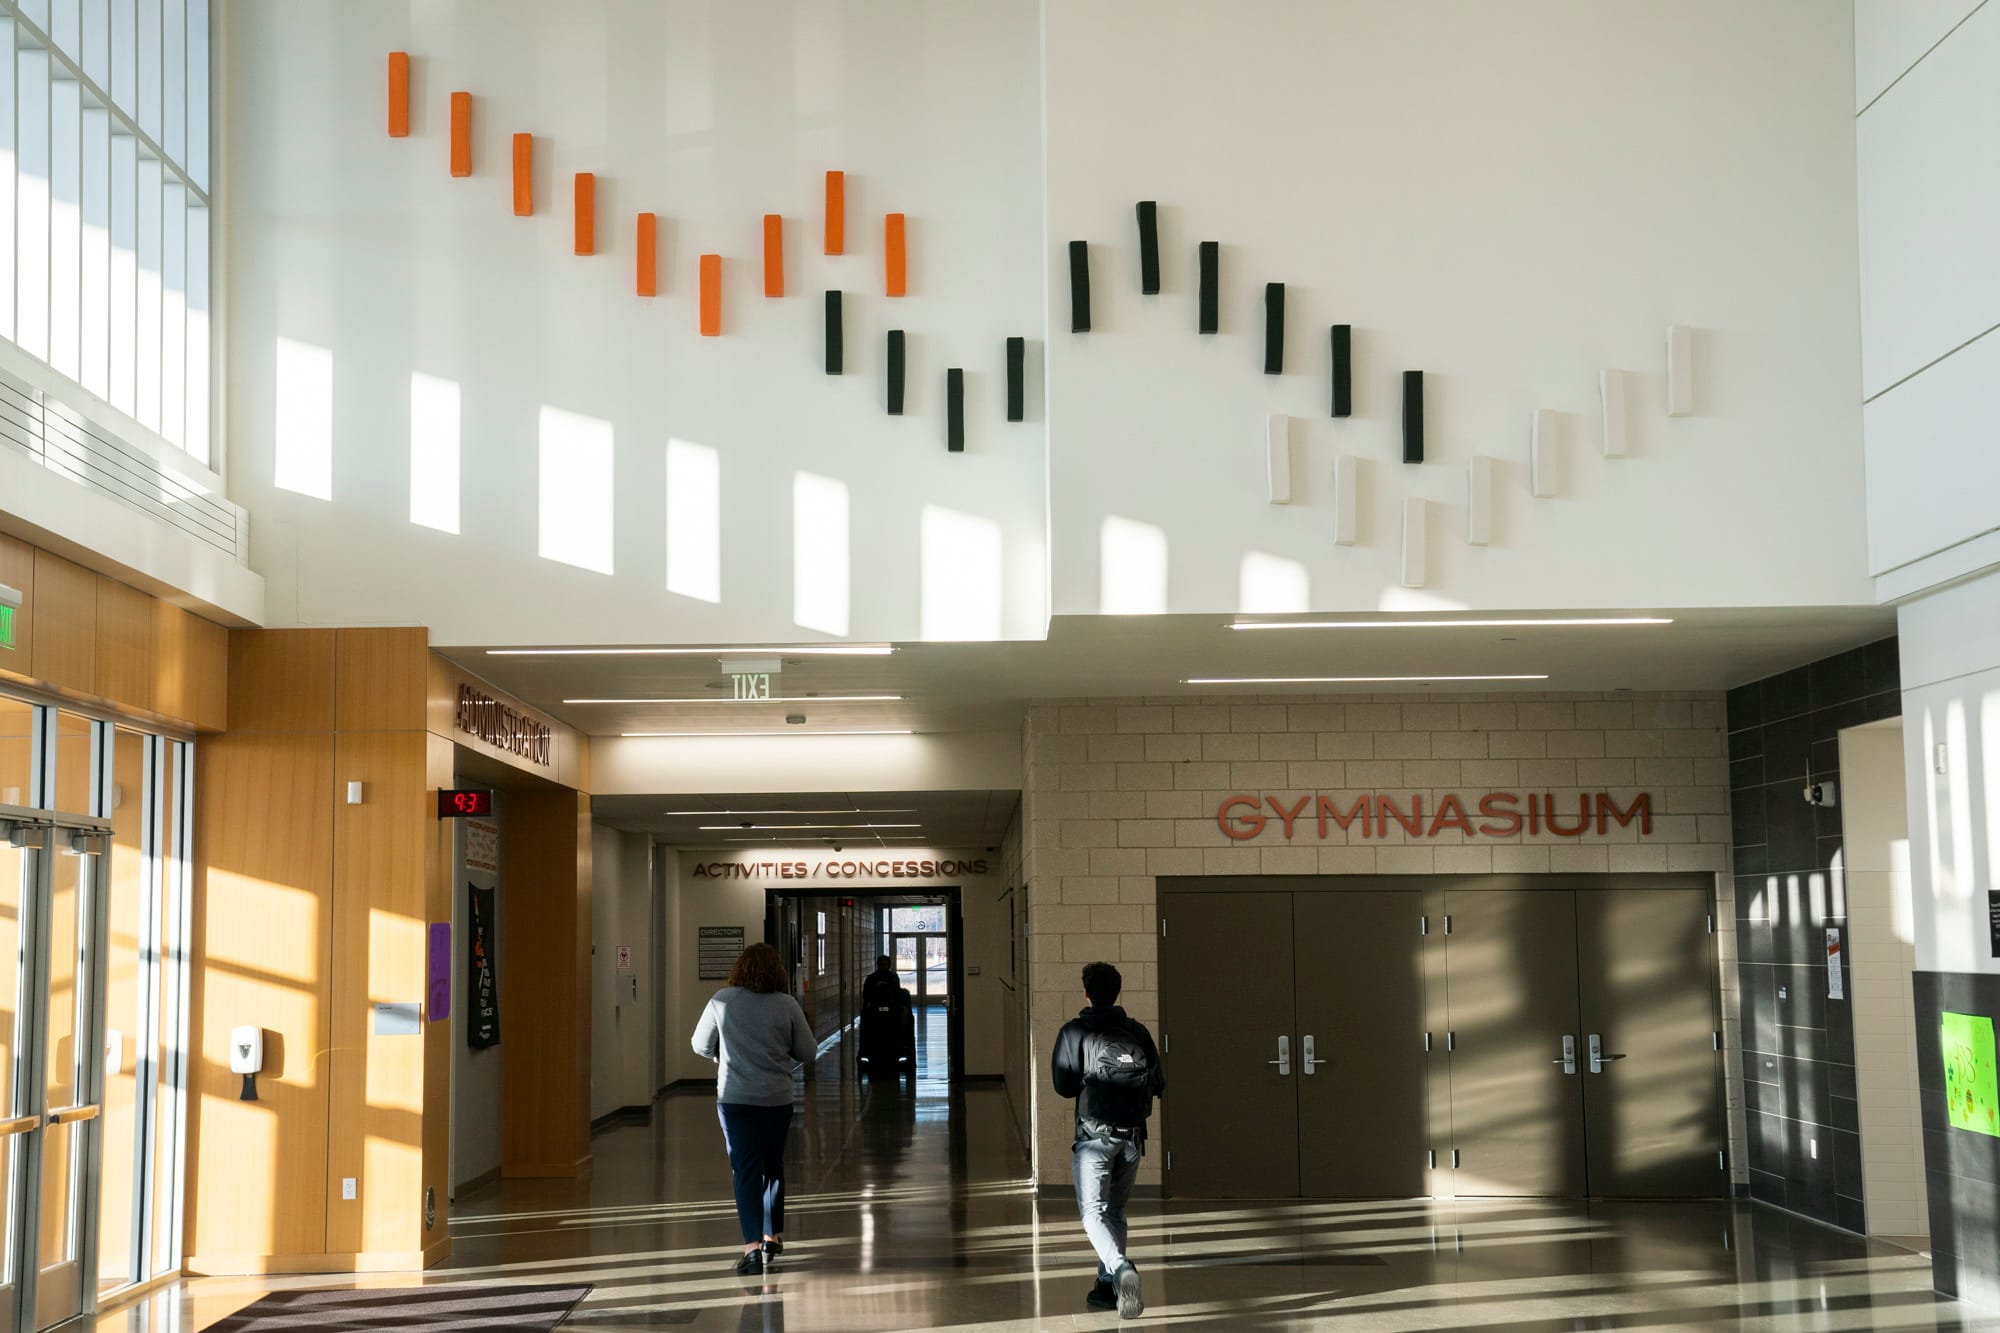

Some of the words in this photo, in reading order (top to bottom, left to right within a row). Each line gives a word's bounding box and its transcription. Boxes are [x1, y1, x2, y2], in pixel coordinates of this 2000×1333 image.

[0, 605, 13, 644] XIT
[458, 683, 551, 767] ADMINISTRATION
[1218, 793, 1650, 840] GYMNASIUM
[693, 862, 808, 879] ACTIVITIES
[826, 860, 988, 877] CONCESSIONS
[700, 928, 743, 936] DIRECTORY
